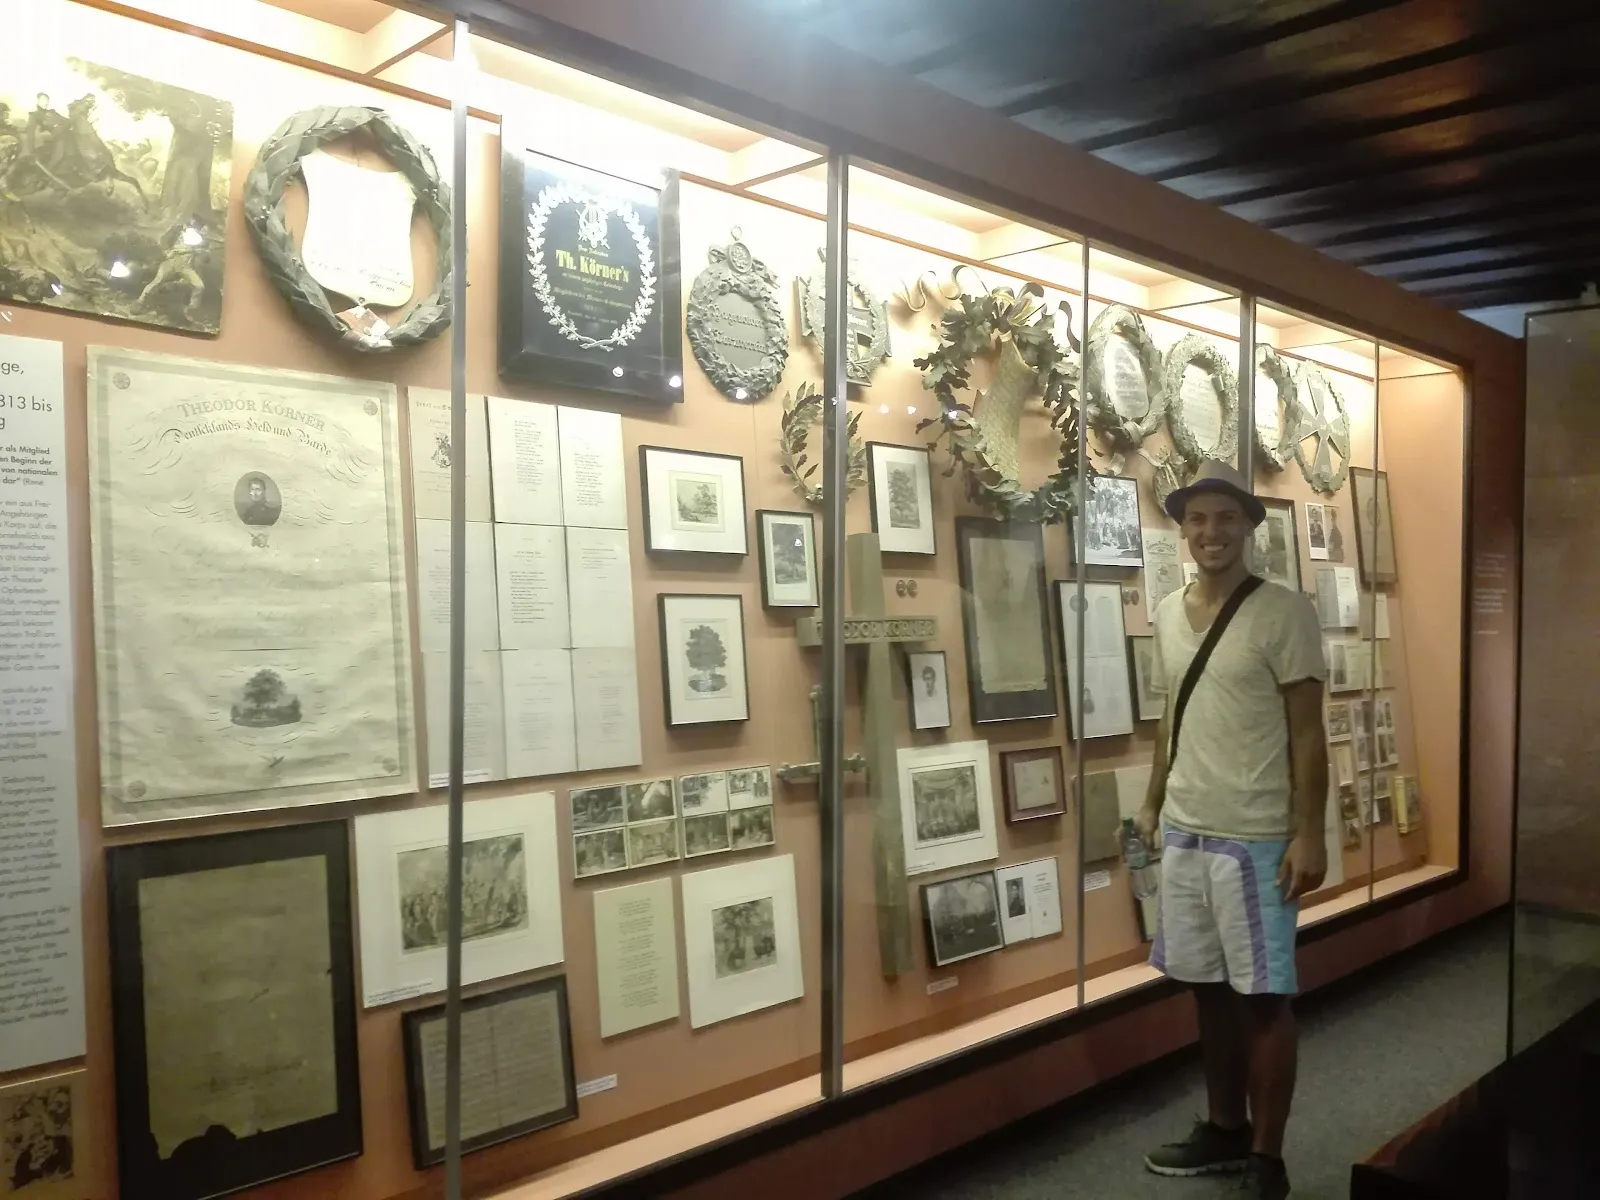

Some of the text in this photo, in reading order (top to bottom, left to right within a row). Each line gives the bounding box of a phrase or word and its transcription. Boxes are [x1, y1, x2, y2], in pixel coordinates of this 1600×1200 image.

[555, 249, 577, 271] Th.
[580, 255, 630, 283] Körner's
[31, 396, 52, 412] bis
[176, 399, 257, 418] THEODOR
[5, 444, 50, 456] als Mitglied
[10, 456, 37, 466] Beginn
[39, 457, 52, 465] der
[18, 468, 58, 476] nationalen
